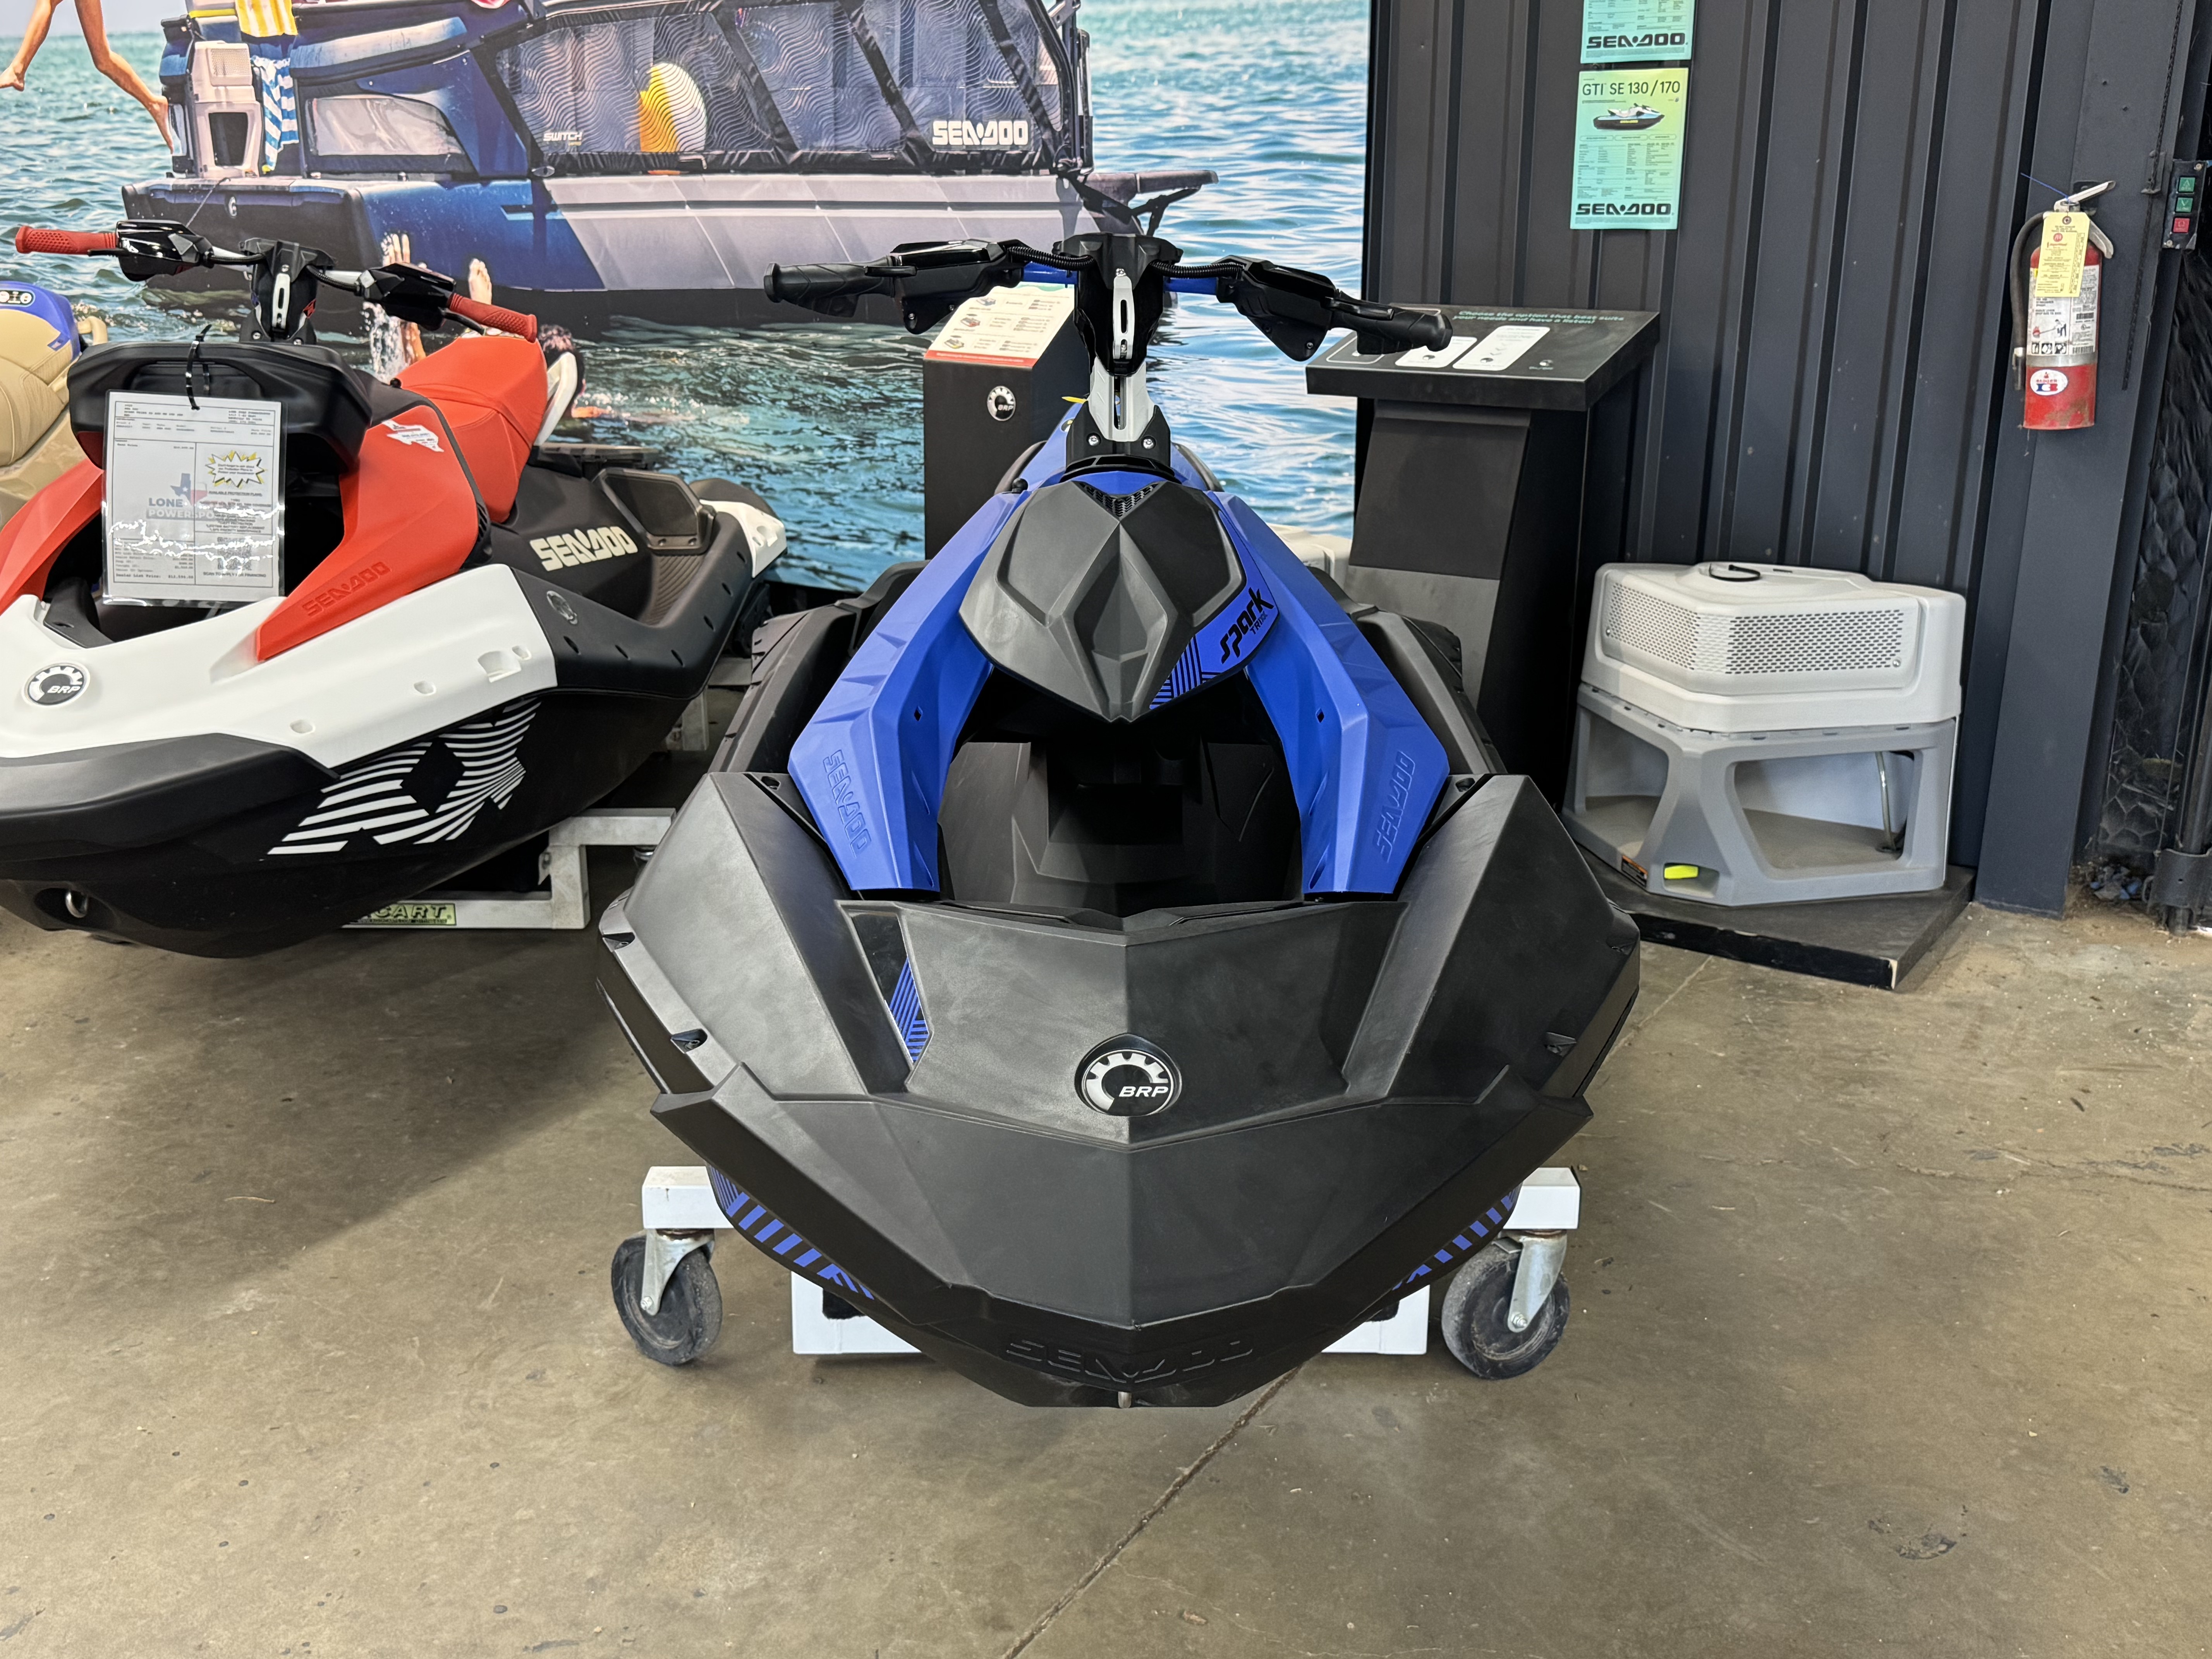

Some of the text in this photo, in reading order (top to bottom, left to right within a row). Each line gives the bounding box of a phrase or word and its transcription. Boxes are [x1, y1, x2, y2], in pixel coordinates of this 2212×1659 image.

[1609, 82, 1625, 95] SE
[543, 132, 583, 141] SWITCH
[149, 498, 184, 507] LONE
[47, 685, 81, 694] BRP
[1118, 1086, 1169, 1097] BRP
